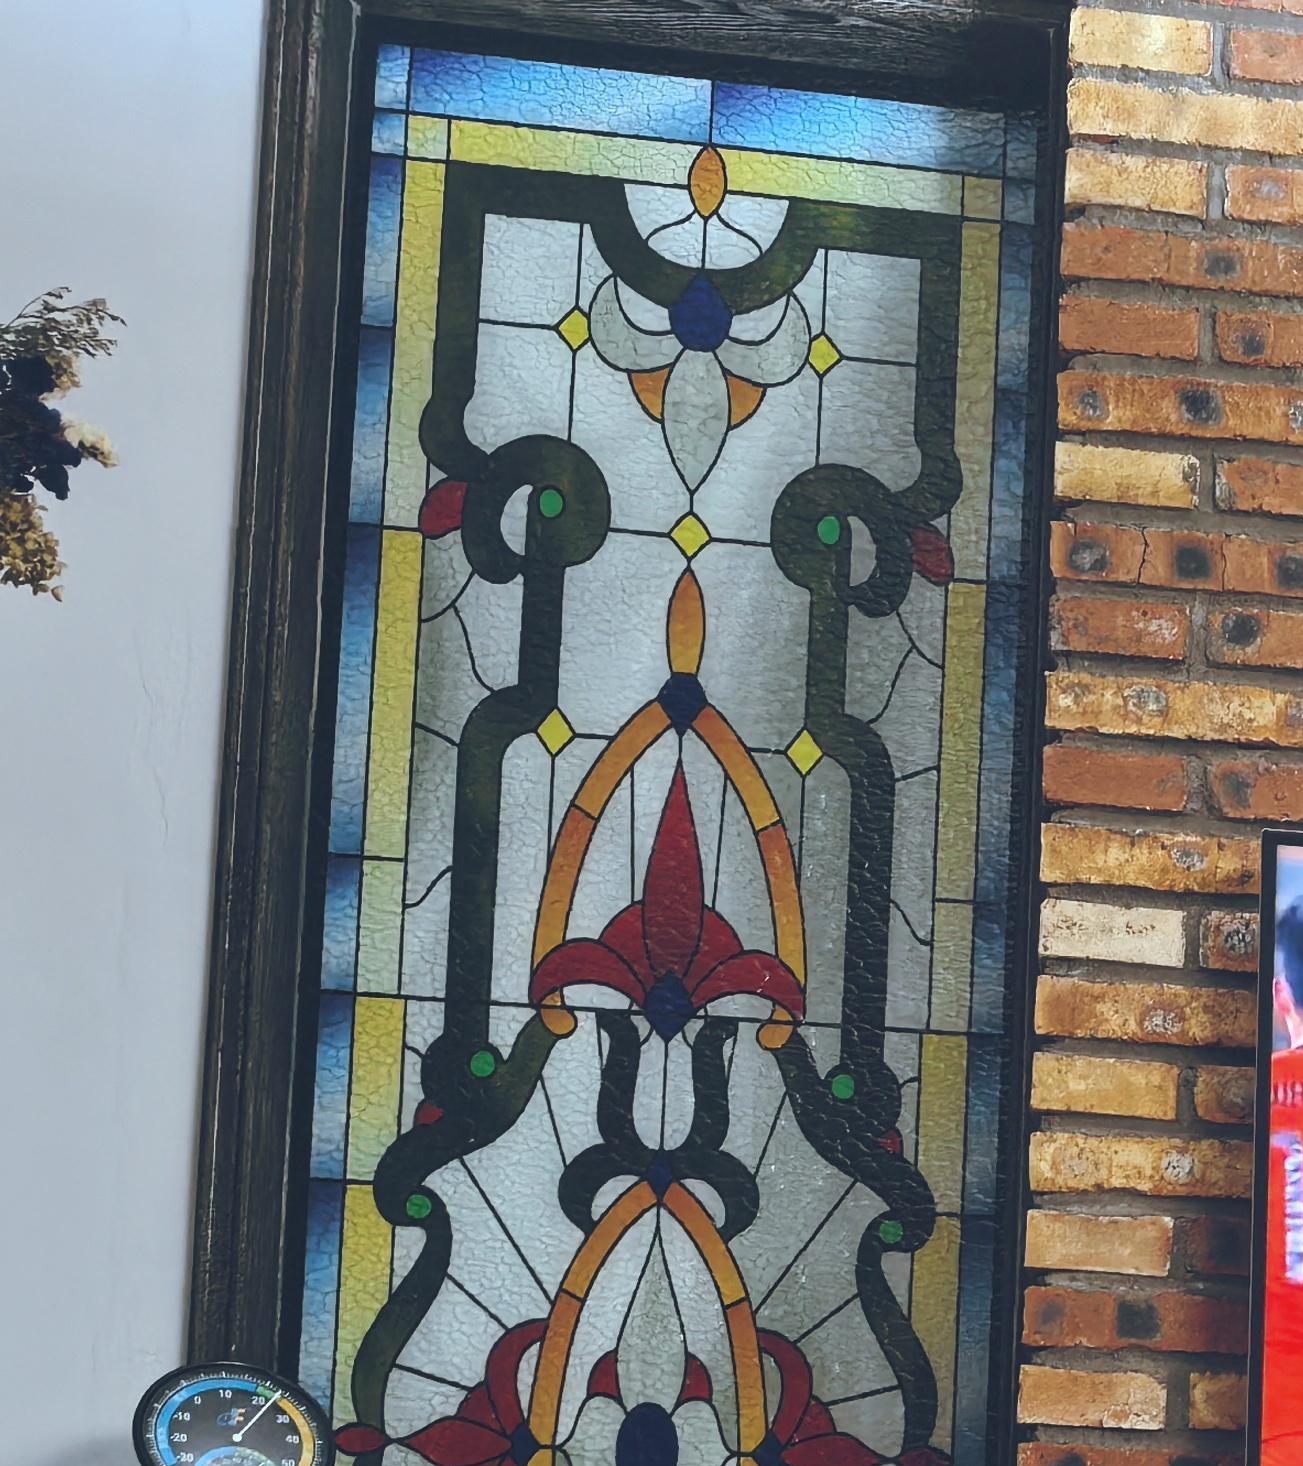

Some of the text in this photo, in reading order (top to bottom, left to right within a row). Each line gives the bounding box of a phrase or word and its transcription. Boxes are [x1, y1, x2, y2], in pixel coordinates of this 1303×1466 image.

[219, 1389, 232, 1398] 10
[251, 1396, 265, 1405] 20
[276, 1415, 289, 1423] 30
